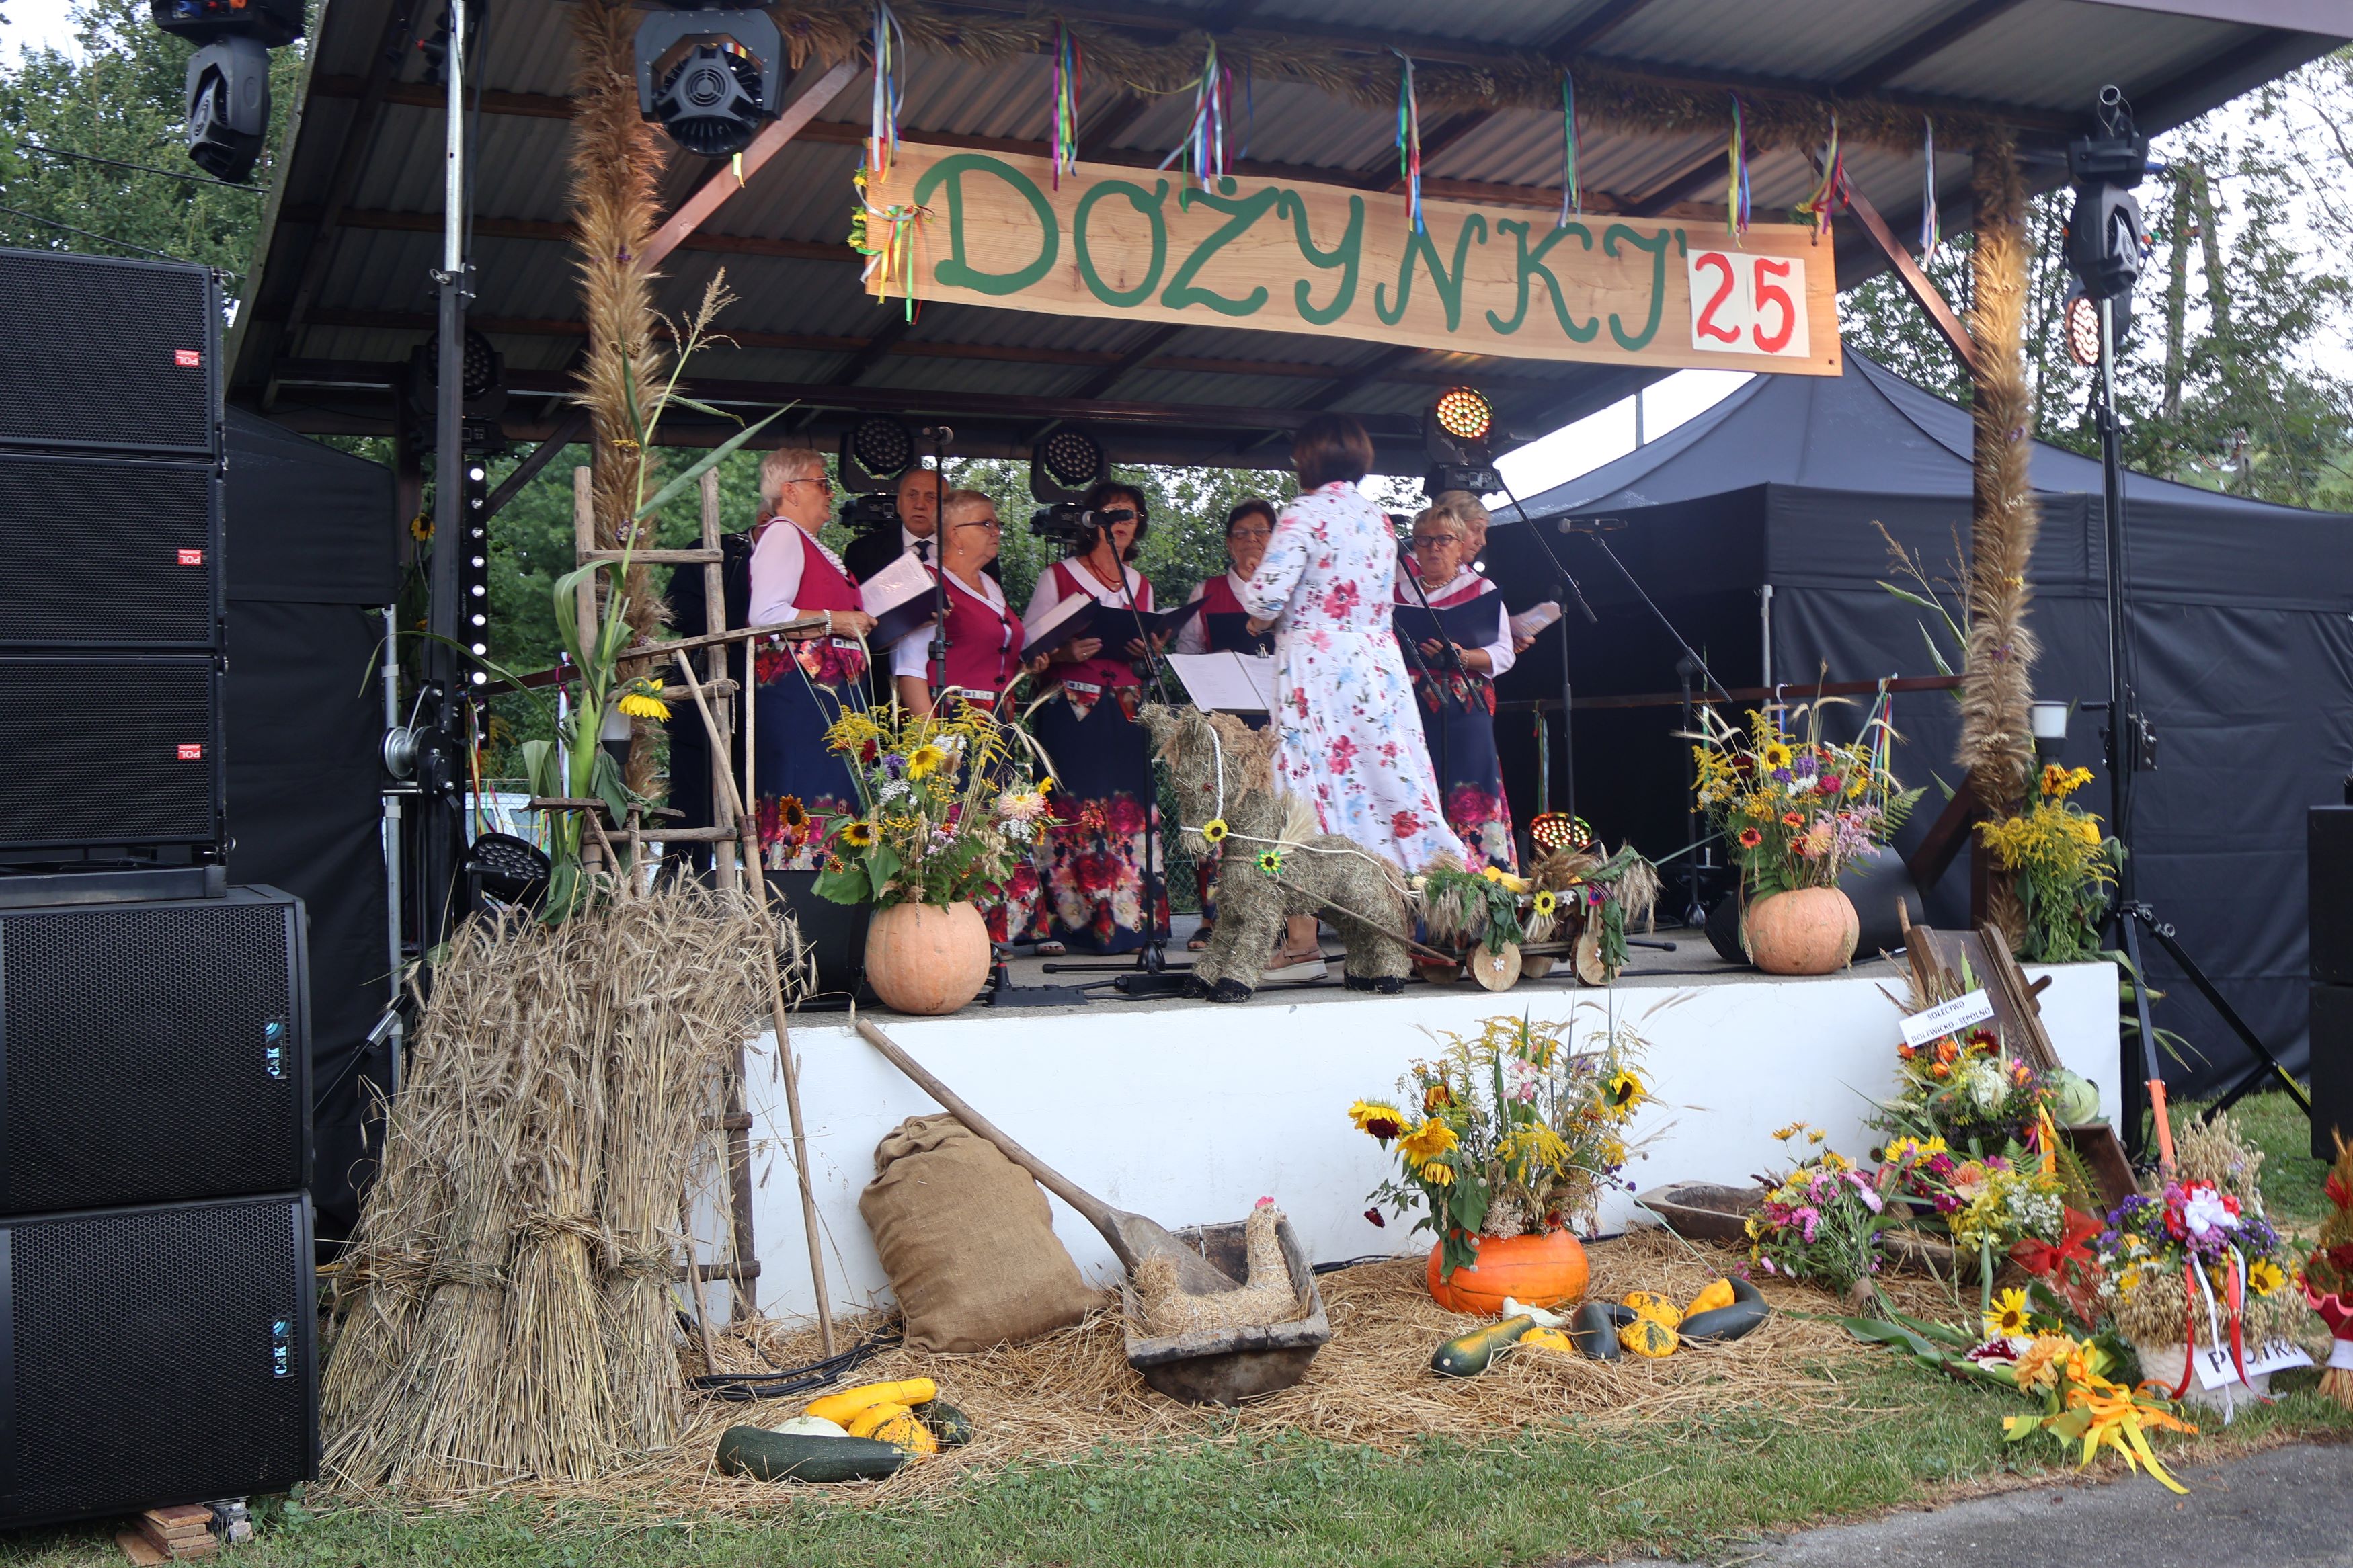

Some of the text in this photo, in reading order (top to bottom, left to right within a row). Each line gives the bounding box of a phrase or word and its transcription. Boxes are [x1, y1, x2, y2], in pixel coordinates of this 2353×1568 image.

[176, 356, 199, 366] POL
[179, 556, 201, 564] POL
[178, 751, 201, 759] POL
[267, 1047, 280, 1076] C&K
[274, 1346, 288, 1374] C&K
